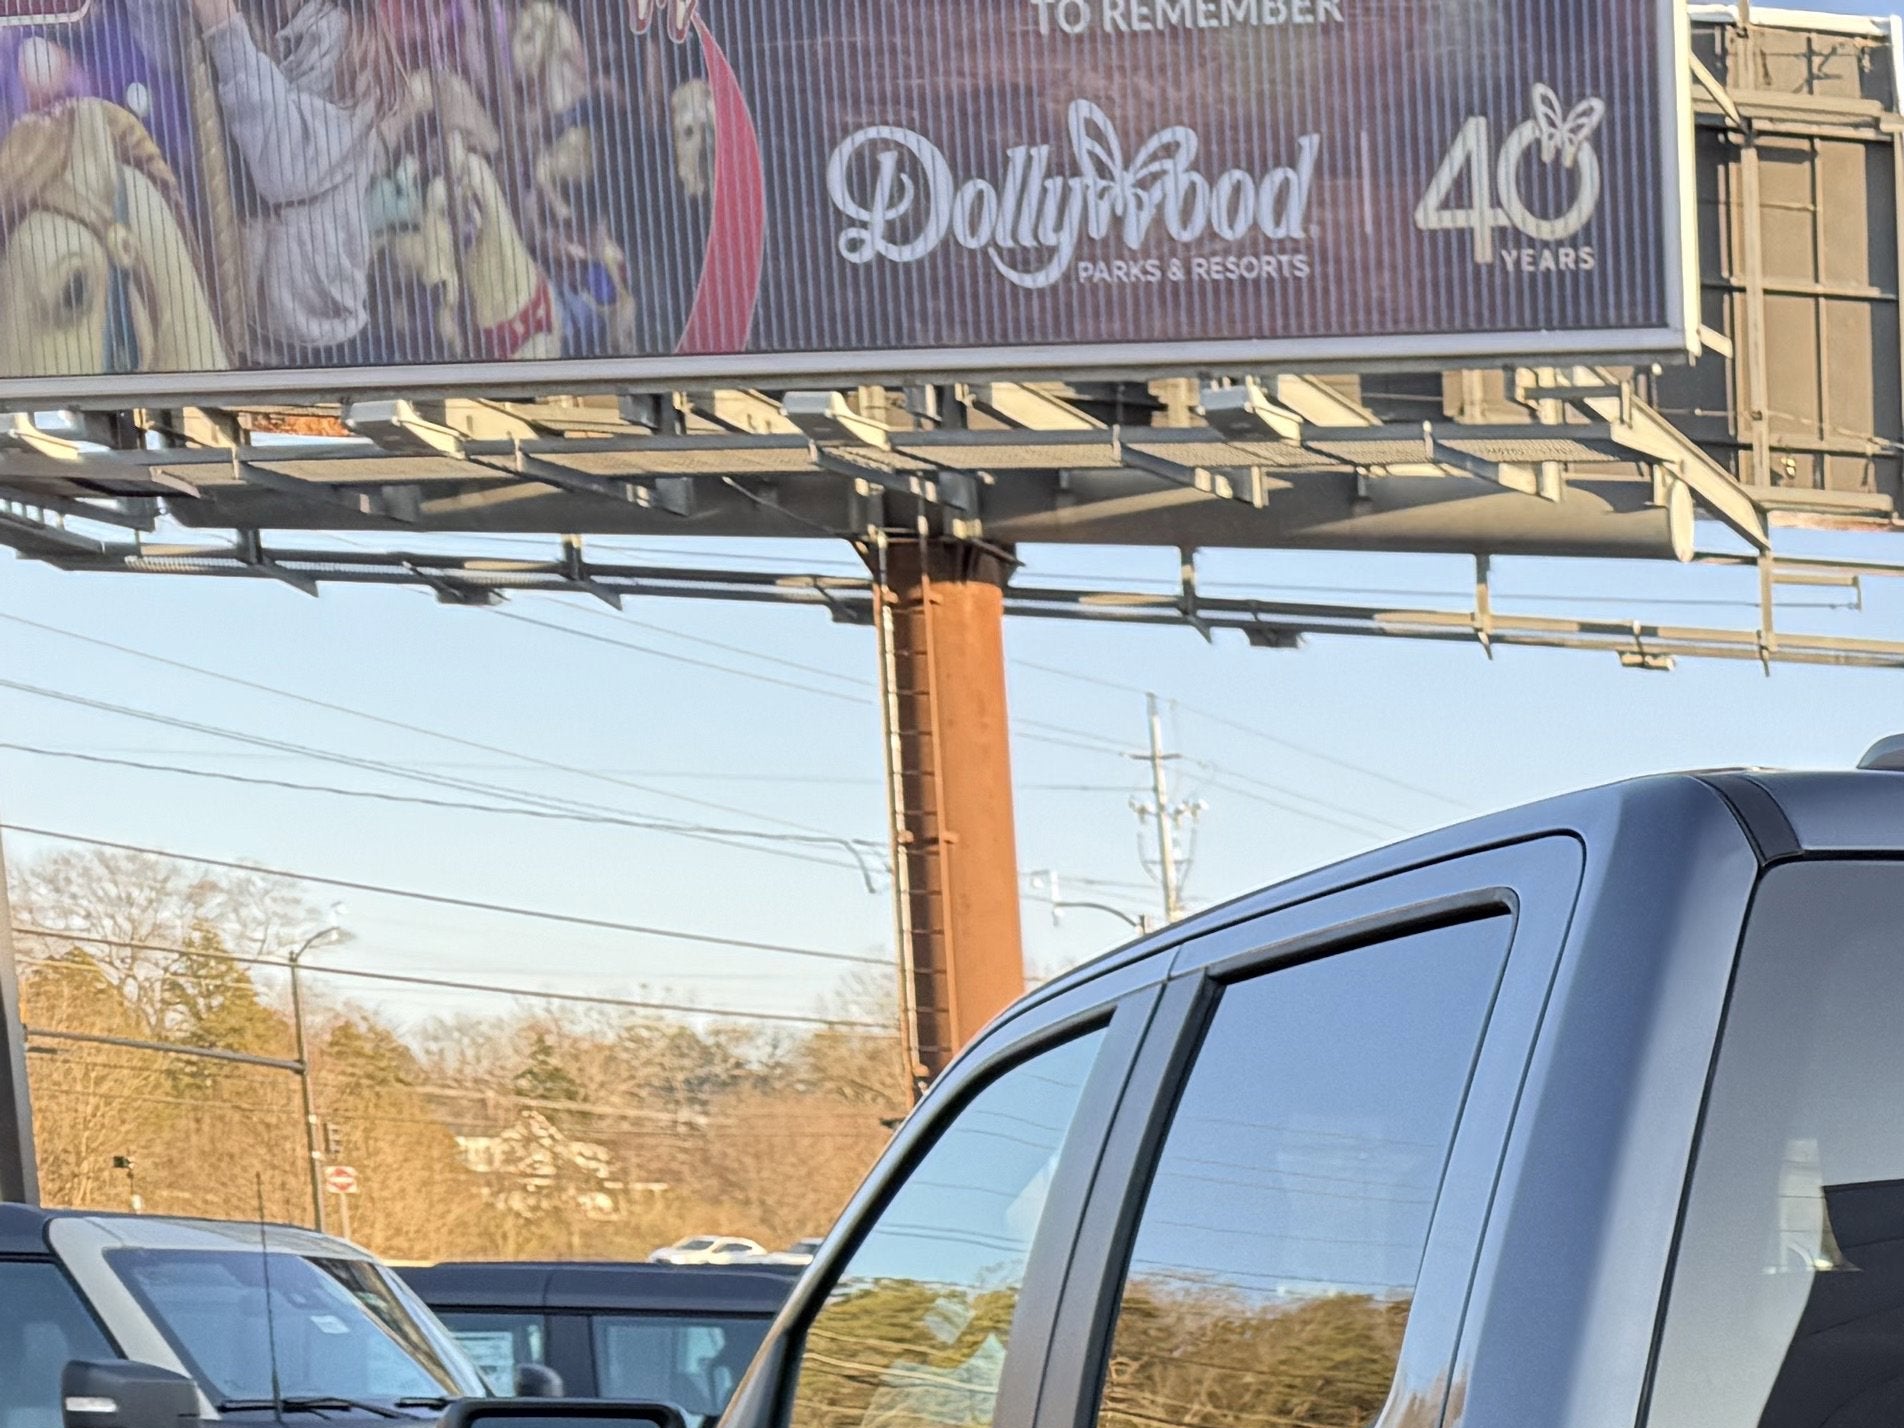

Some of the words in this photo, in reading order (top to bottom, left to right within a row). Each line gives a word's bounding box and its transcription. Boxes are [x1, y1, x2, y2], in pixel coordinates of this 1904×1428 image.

[1031, 0, 1091, 35] TO
[1102, 0, 1344, 32] REMEMBER
[826, 99, 1320, 288] Dollywood
[1414, 112, 1602, 263] 40
[1078, 258, 1162, 283] PARKS
[1167, 257, 1183, 281] &
[1191, 254, 1310, 280] RESORTS
[1500, 246, 1596, 272] YEARS
